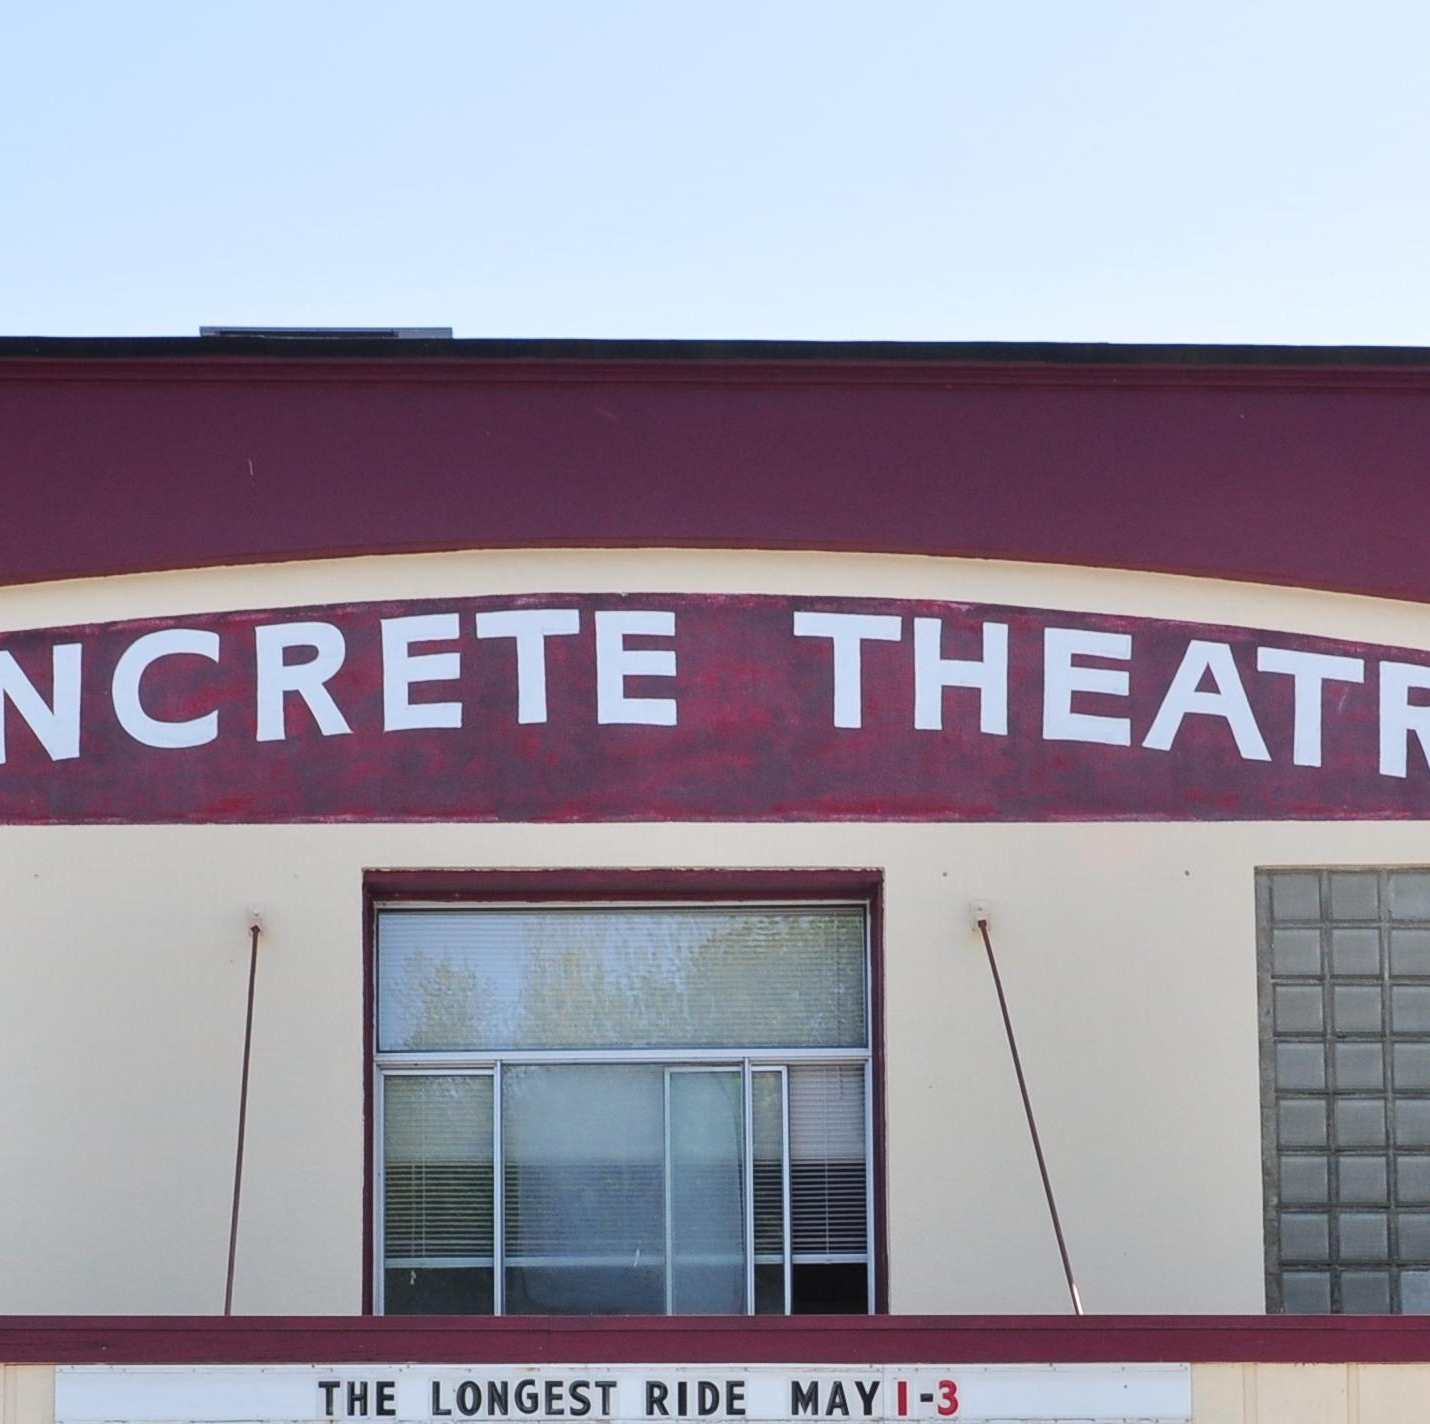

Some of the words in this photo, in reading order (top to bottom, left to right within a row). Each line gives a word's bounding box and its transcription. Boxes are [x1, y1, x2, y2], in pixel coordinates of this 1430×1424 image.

[318, 1380, 396, 1416] THE
[431, 1380, 617, 1417] LONGEST
[645, 1380, 746, 1416] RIDE
[790, 1380, 881, 1416] MAY
[897, 1380, 960, 1416] 1-3
